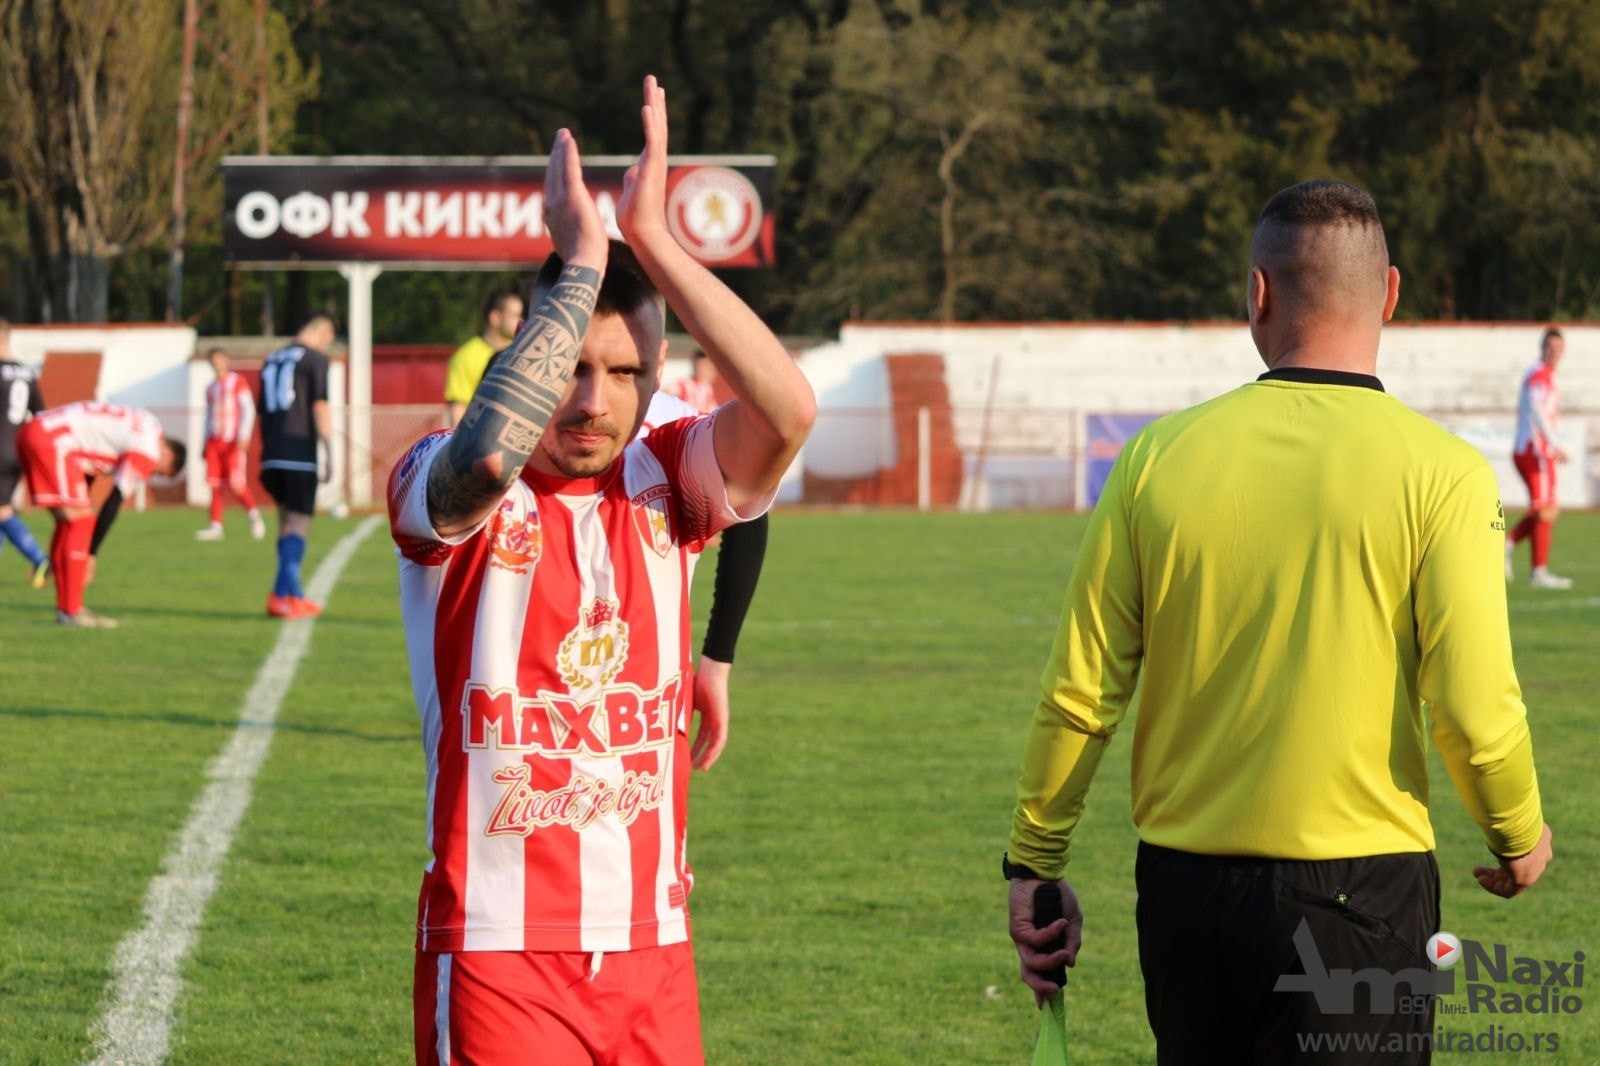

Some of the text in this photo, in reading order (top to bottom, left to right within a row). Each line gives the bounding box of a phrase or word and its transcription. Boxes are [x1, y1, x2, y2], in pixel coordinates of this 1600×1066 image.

[235, 191, 371, 240] ОФК
[486, 767, 590, 835] Život
[578, 780, 615, 827] je
